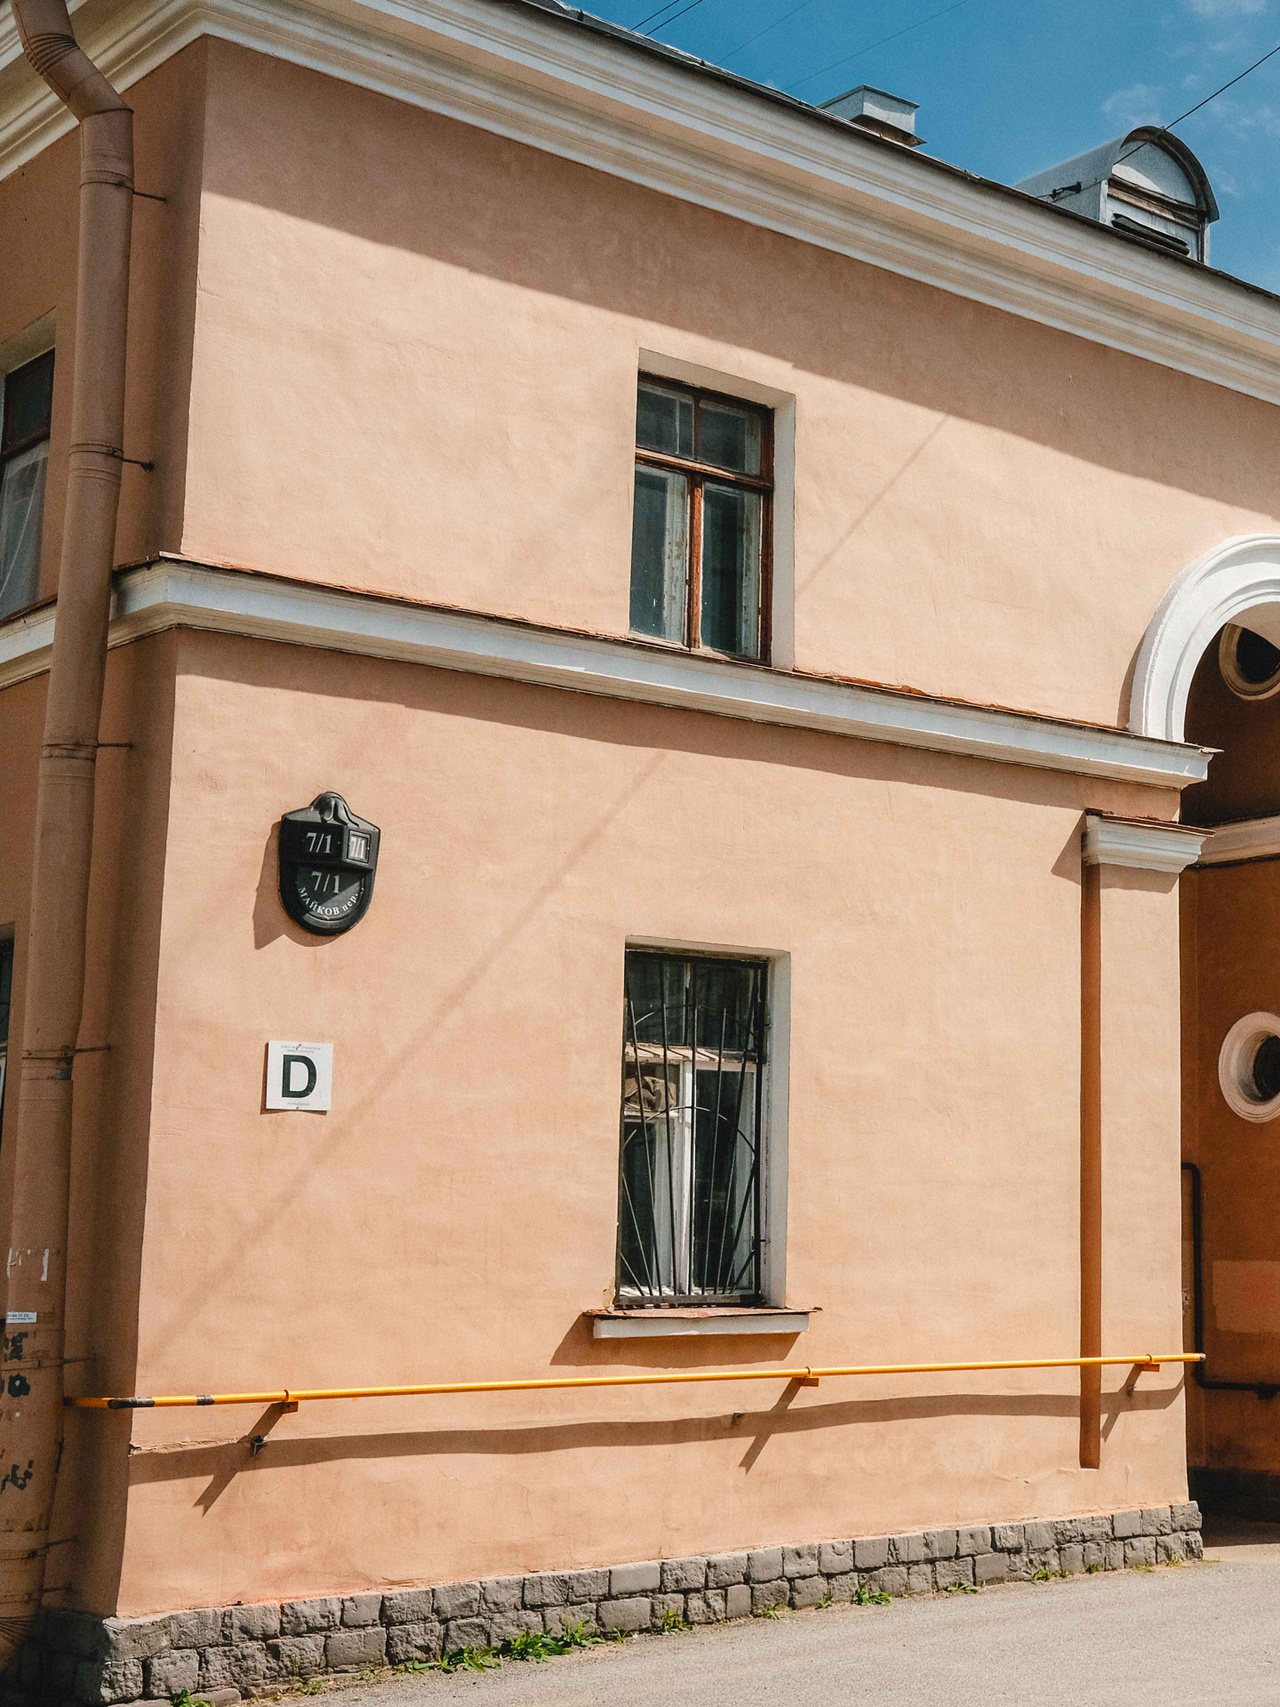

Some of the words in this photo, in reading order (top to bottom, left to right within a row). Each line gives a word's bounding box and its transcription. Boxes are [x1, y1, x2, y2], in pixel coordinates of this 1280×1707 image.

[306, 832, 332, 854] 7/1
[350, 835, 366, 860] 7/1
[311, 871, 340, 894] 7/1
[298, 887, 339, 916] МАЙКОВ
[281, 1054, 317, 1098] D
